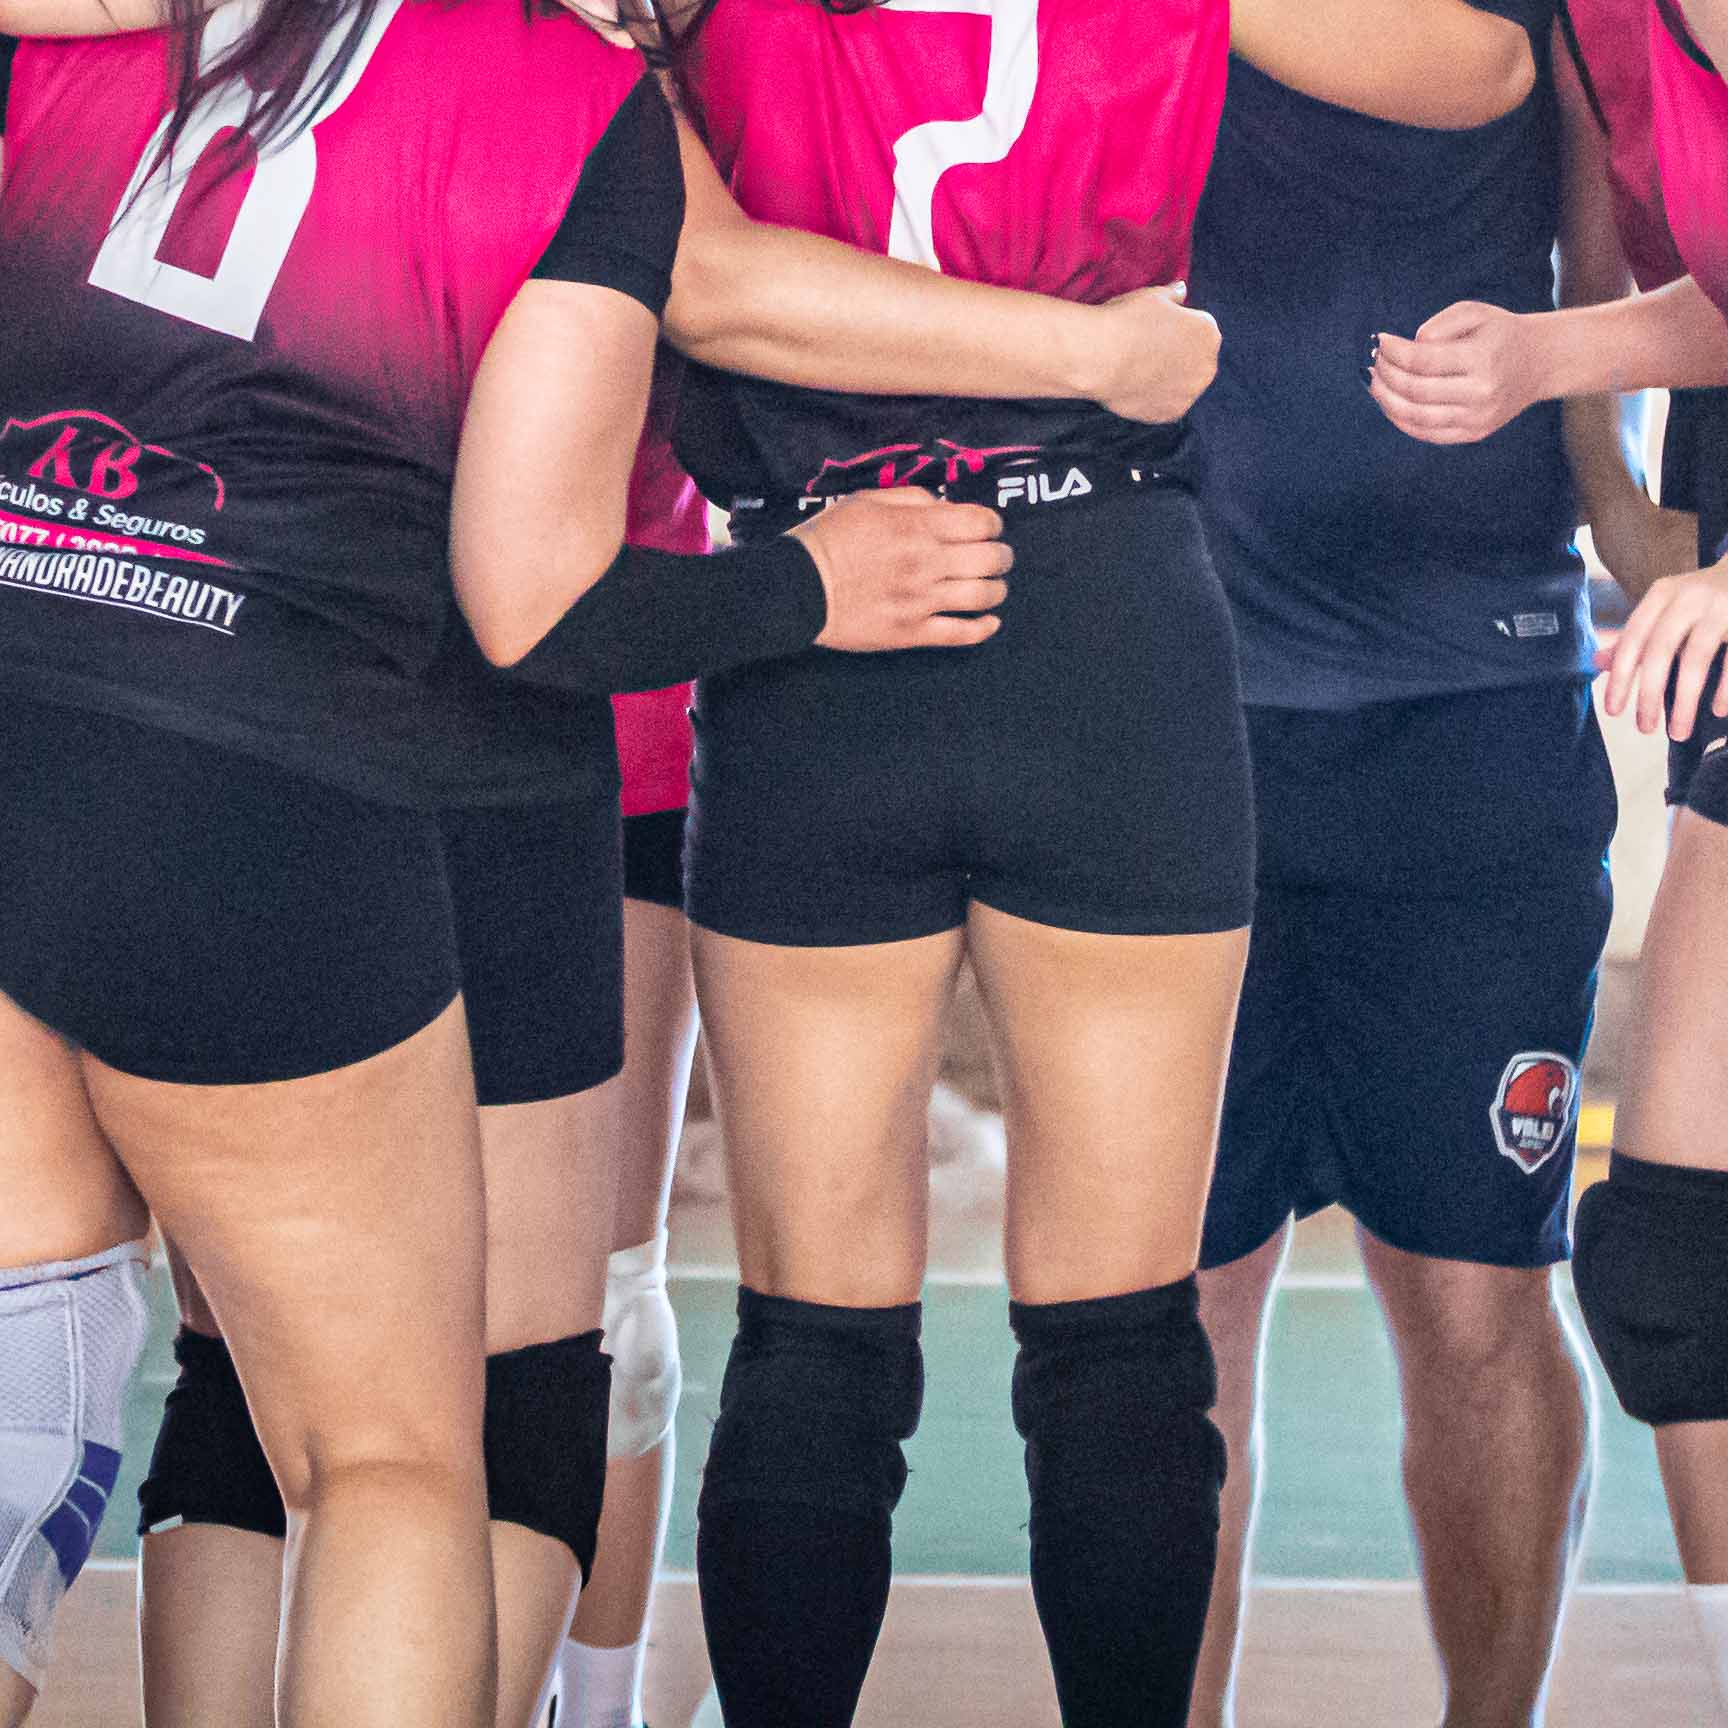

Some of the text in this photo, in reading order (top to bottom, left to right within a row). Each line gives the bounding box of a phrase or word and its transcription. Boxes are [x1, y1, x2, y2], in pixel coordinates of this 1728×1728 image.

[27, 425, 141, 500] KB
[997, 467, 1093, 508] FILA
[67, 498, 89, 520] &
[93, 504, 206, 545] Seguros
